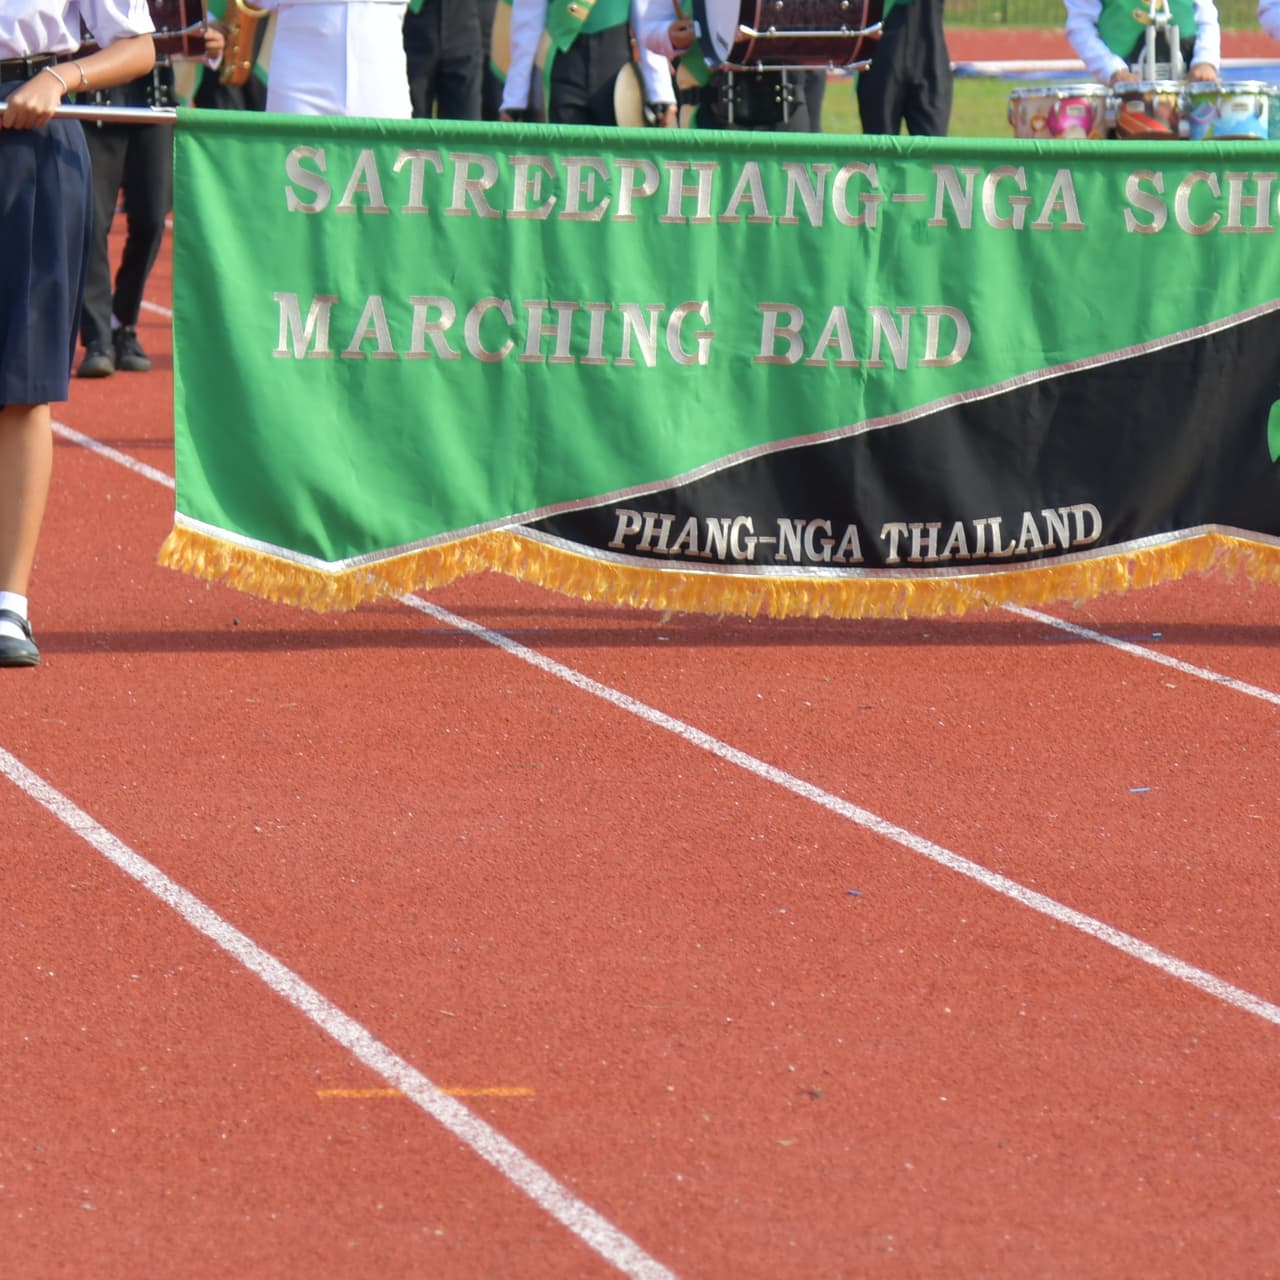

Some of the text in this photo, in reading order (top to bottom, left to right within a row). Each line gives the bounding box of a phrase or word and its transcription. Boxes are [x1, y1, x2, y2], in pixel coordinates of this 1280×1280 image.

[284, 146, 1084, 230] SATREEPHANG-NGA
[272, 291, 972, 370] MARCHING BAND
[607, 503, 1102, 565] PHANG-NGA THAILAND
